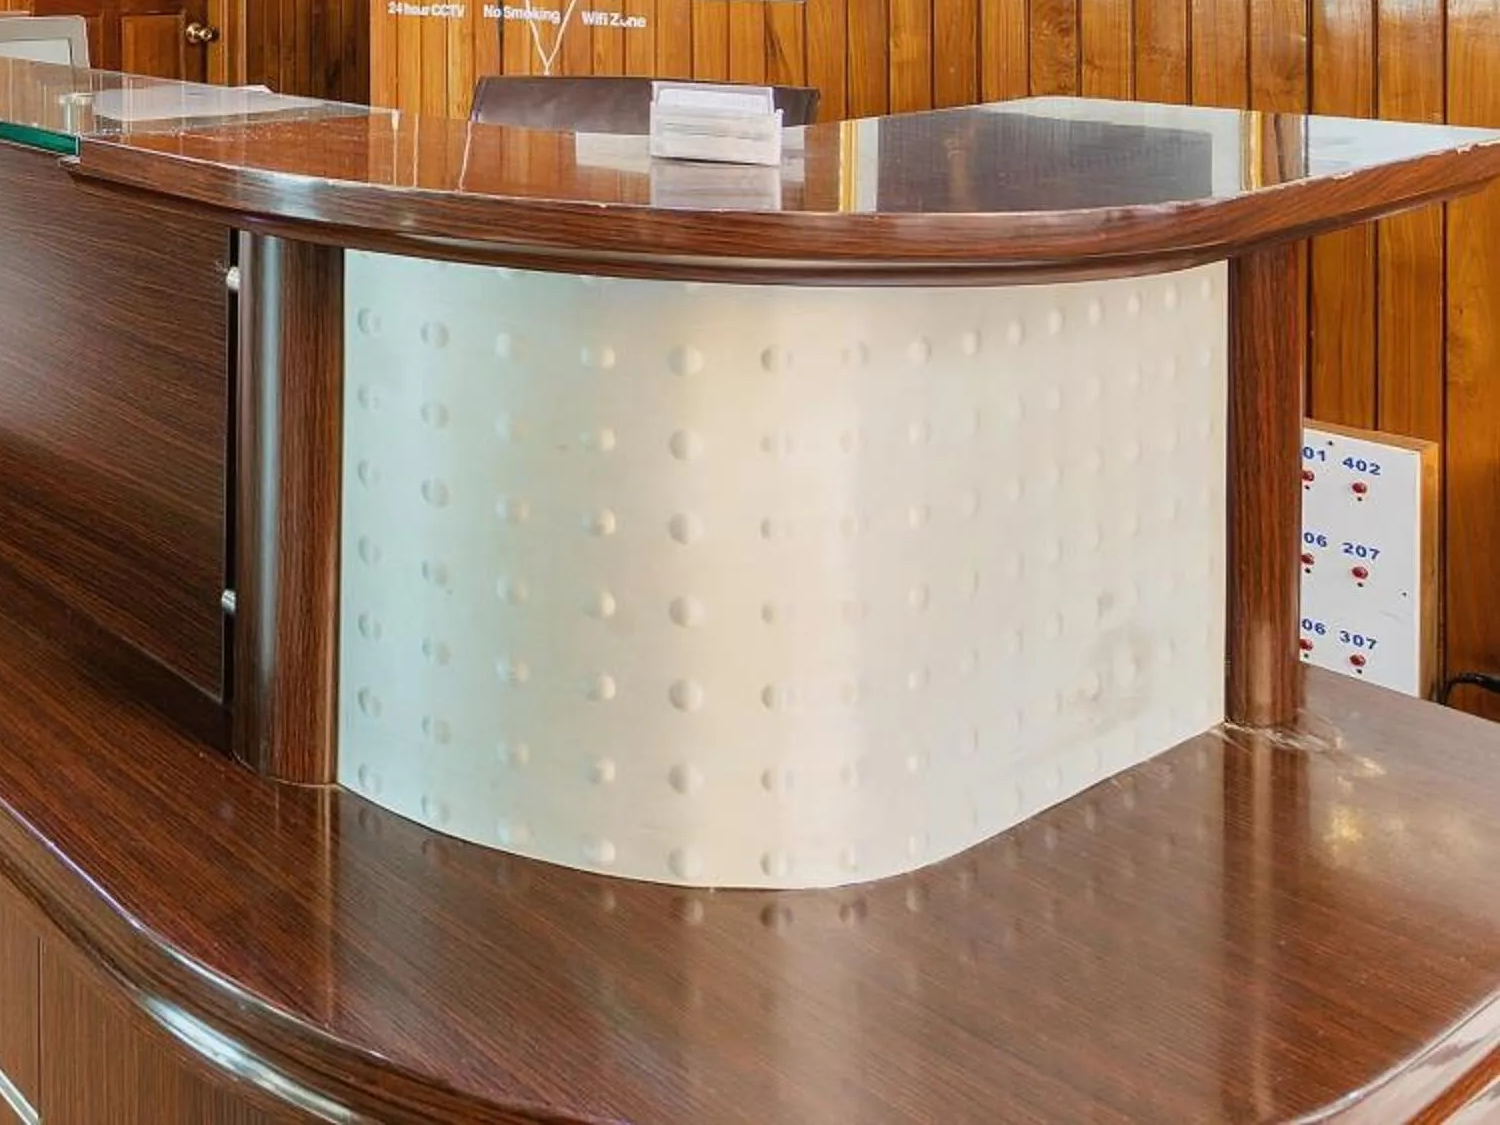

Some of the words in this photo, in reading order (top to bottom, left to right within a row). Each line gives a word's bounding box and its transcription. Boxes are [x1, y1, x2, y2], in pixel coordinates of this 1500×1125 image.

[388, 1, 403, 14] 24
[404, 2, 429, 16] hour
[432, 4, 465, 19] CCTV
[484, 4, 501, 18] No
[503, 5, 561, 24] Smoking
[1303, 446, 1326, 462] 01
[1342, 457, 1381, 476] 402
[1303, 532, 1327, 548] 06
[1342, 542, 1380, 560] 207
[1301, 618, 1326, 636] 06
[1339, 630, 1377, 650] 307
